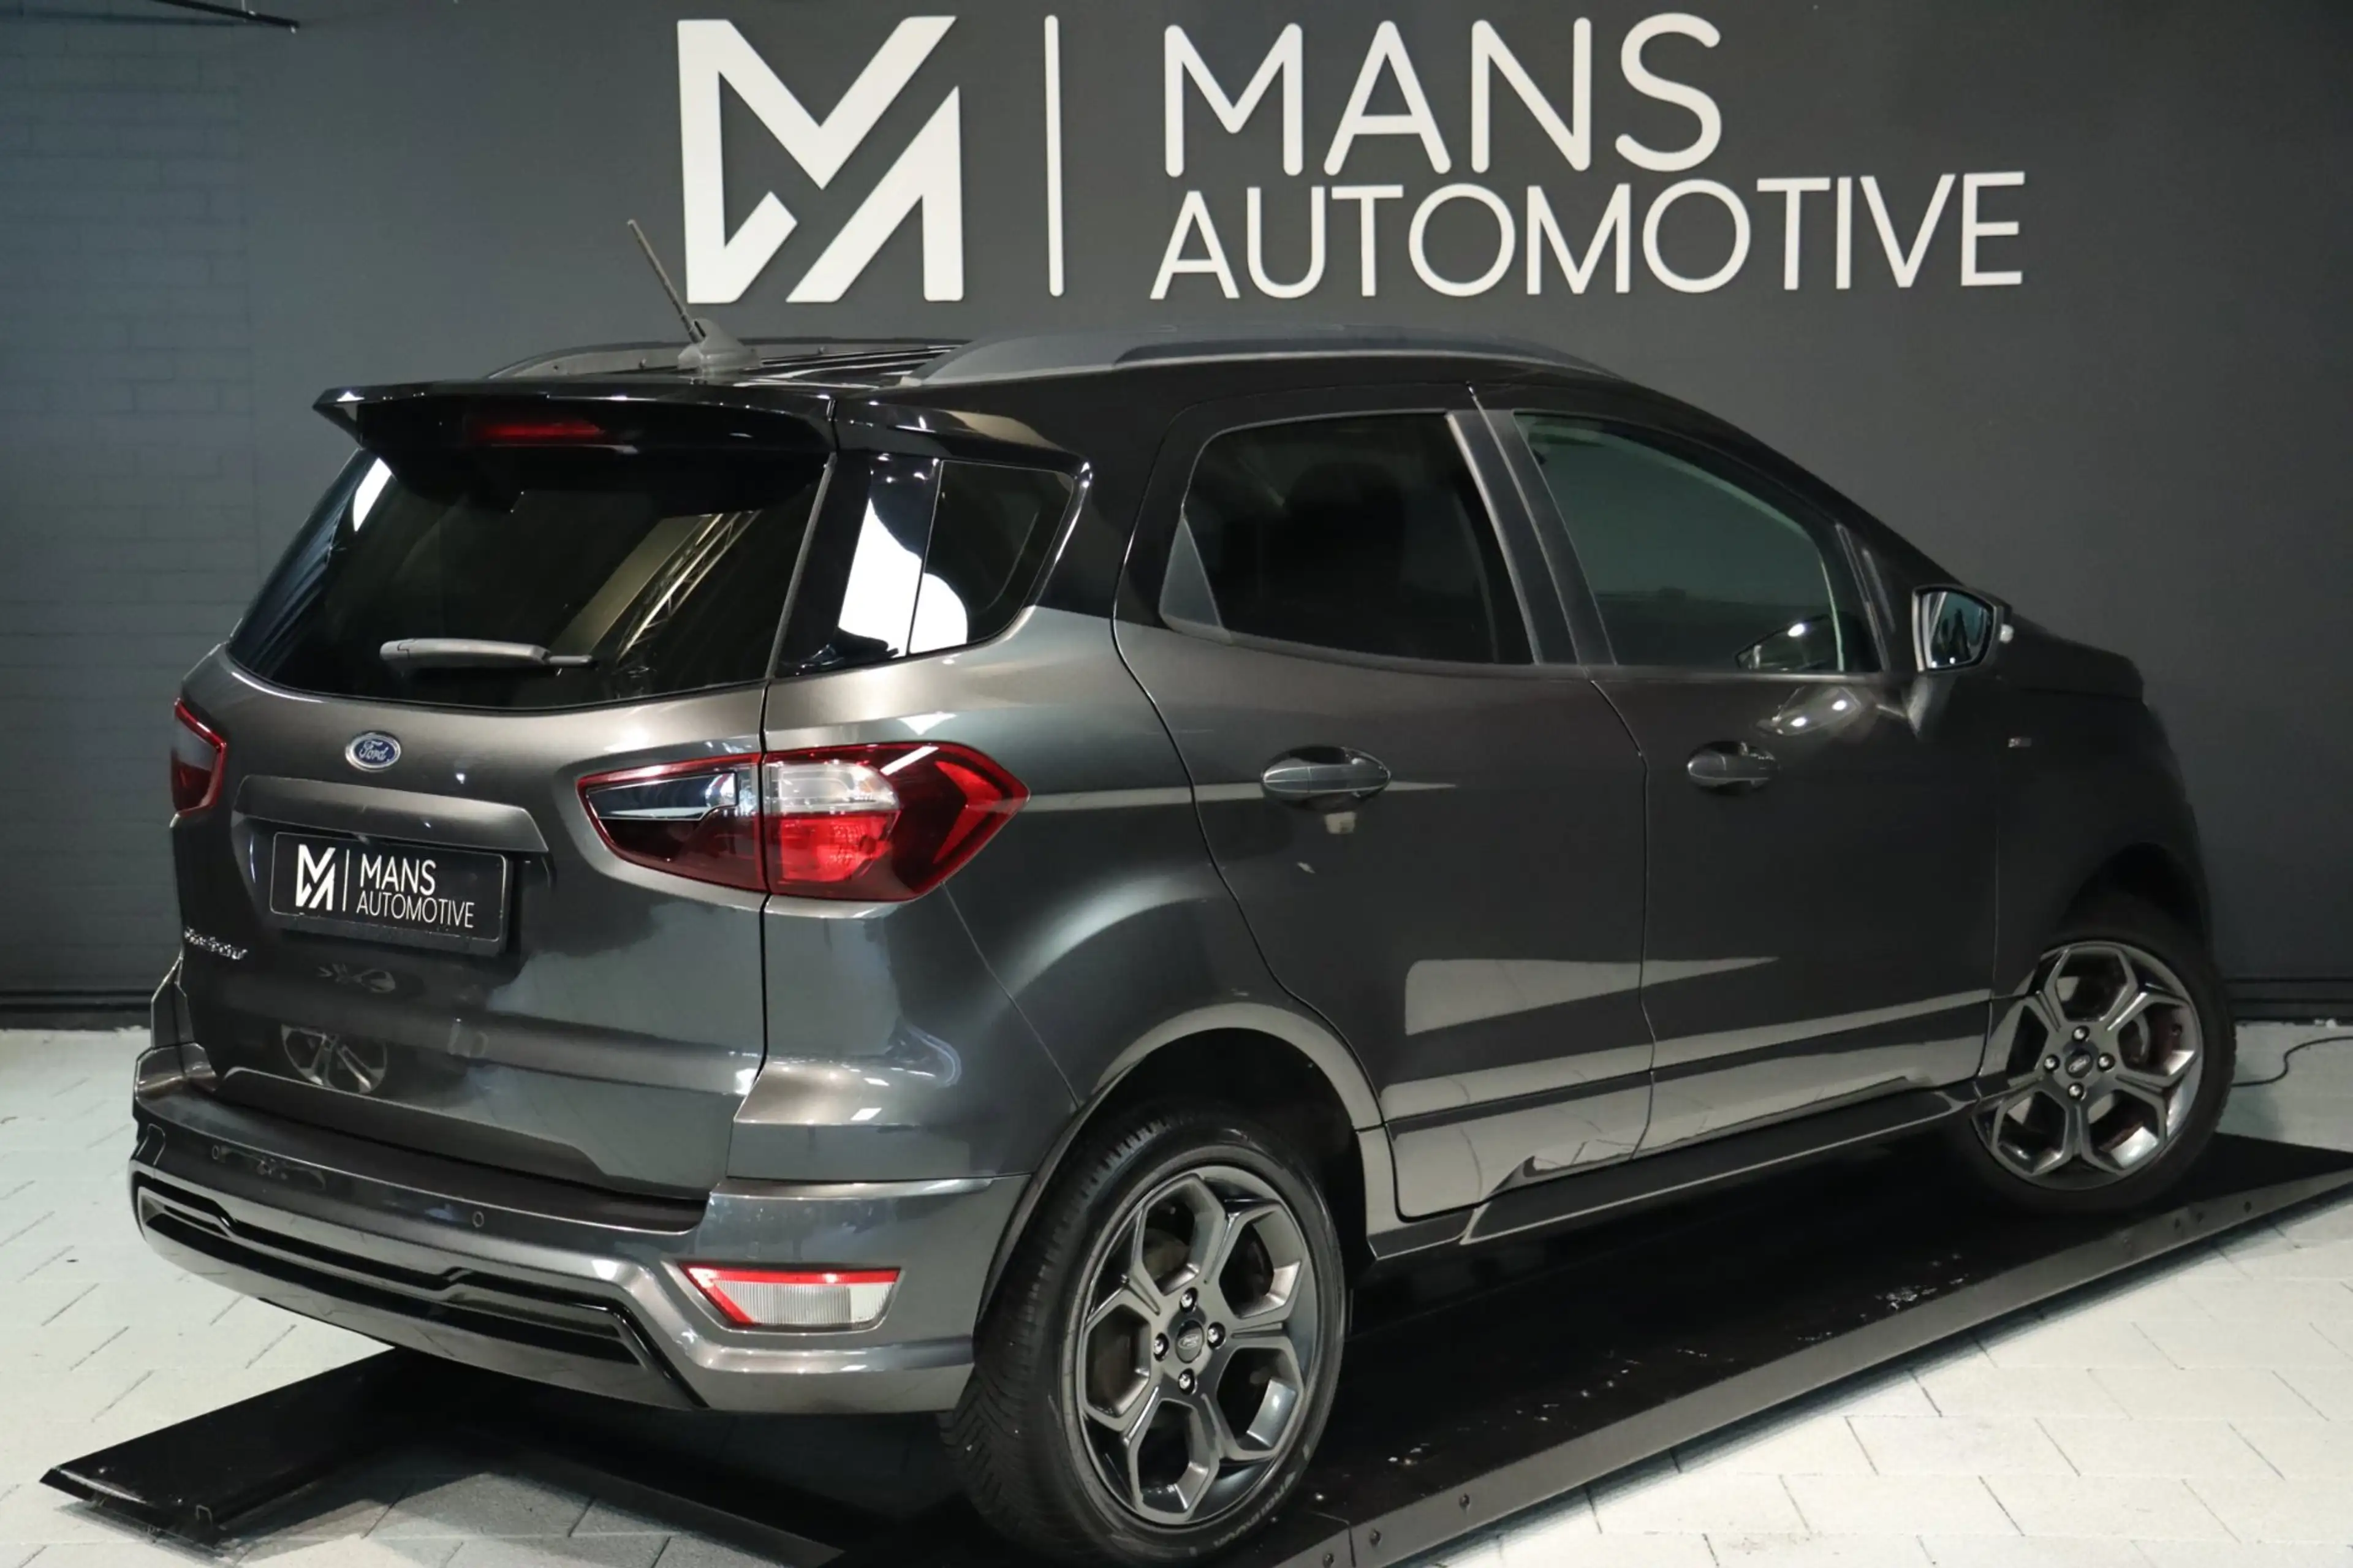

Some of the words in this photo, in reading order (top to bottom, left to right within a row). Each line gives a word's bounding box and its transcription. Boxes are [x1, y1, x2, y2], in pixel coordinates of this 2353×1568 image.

[1164, 13, 1722, 178] MANS
[1150, 171, 2026, 300] AUTOMOTIVE
[358, 740, 390, 762] Ford
[359, 853, 437, 896] MANS
[355, 890, 476, 929] AUTOMOTIVE
